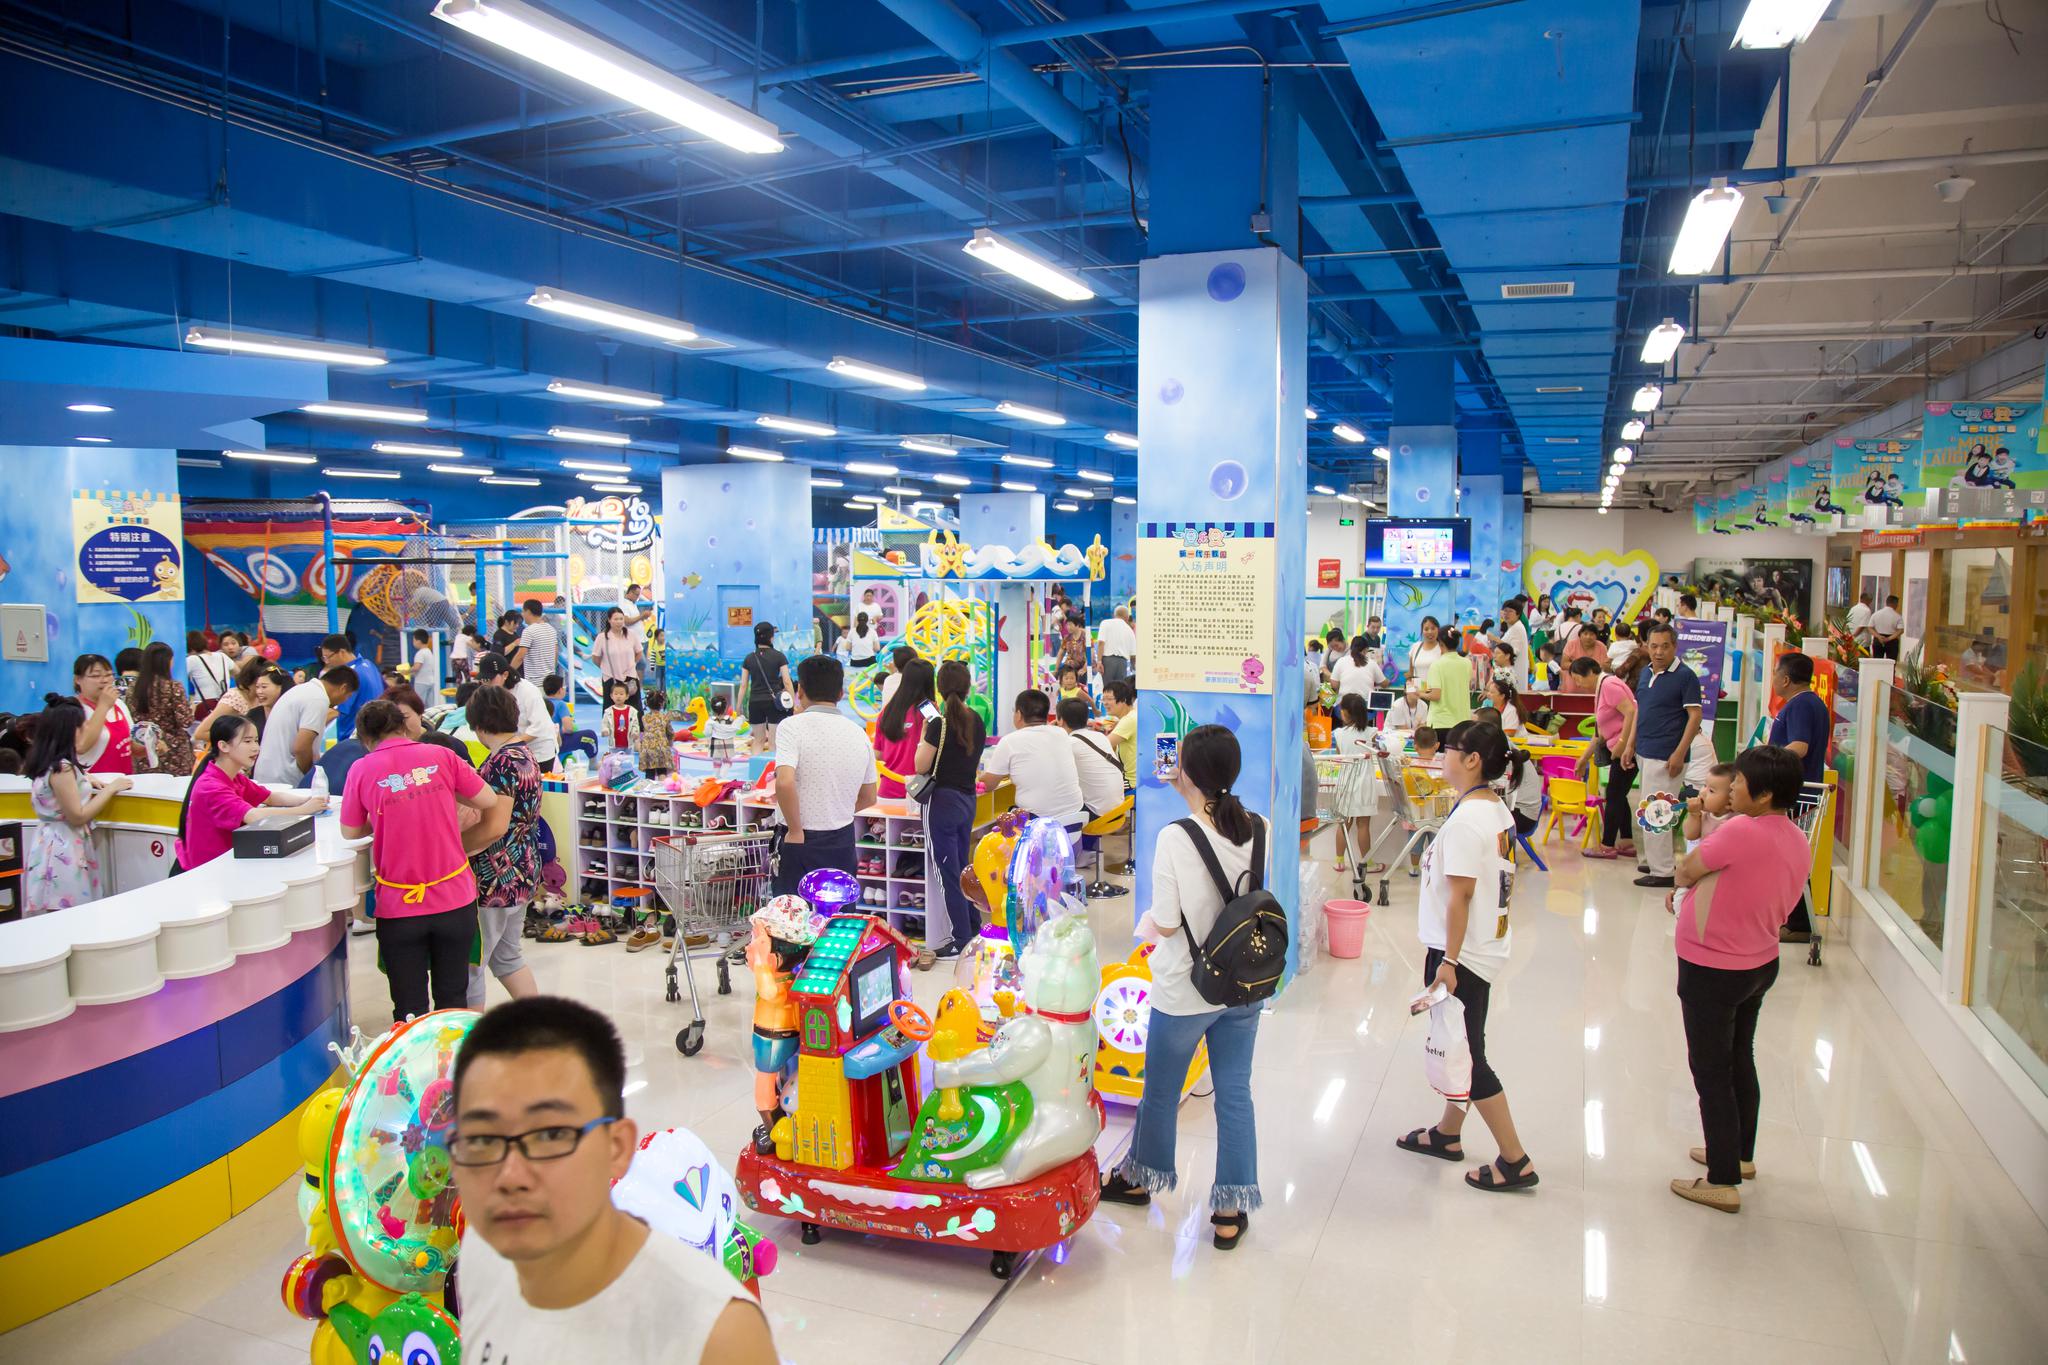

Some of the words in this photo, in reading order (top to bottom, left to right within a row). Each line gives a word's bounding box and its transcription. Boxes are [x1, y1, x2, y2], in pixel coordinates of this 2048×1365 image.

[109, 532, 151, 543] 特别注意
[1178, 560, 1227, 573] 入场声明
[153, 842, 161, 856] 2
